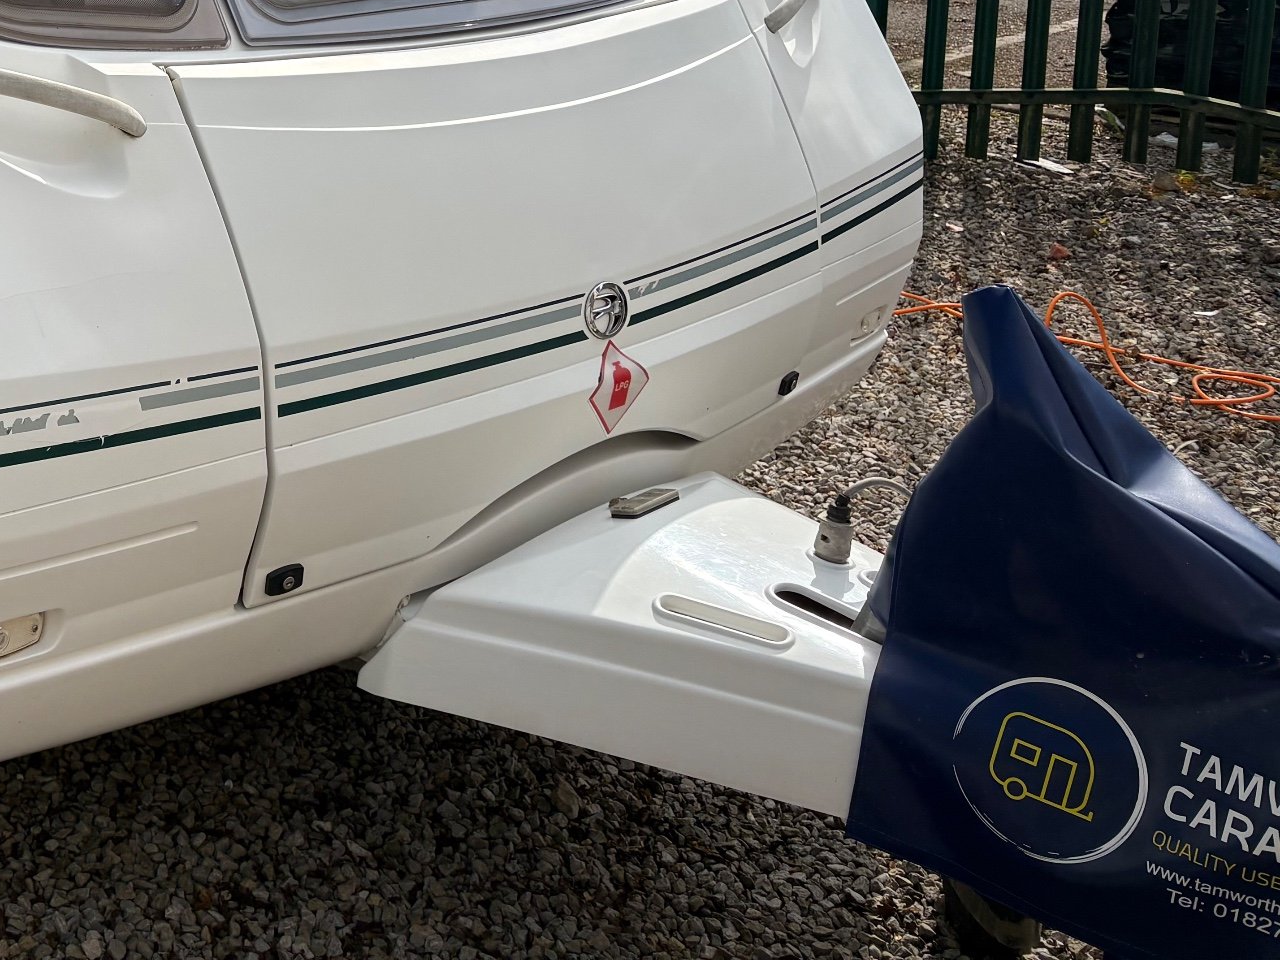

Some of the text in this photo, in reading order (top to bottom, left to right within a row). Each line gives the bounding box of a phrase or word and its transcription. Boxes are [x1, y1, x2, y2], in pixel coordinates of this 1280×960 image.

[615, 380, 629, 392] LPG
[1163, 785, 1280, 863] CARA
[1152, 830, 1237, 876] QUALITY
[1166, 887, 1205, 912] Tel:
